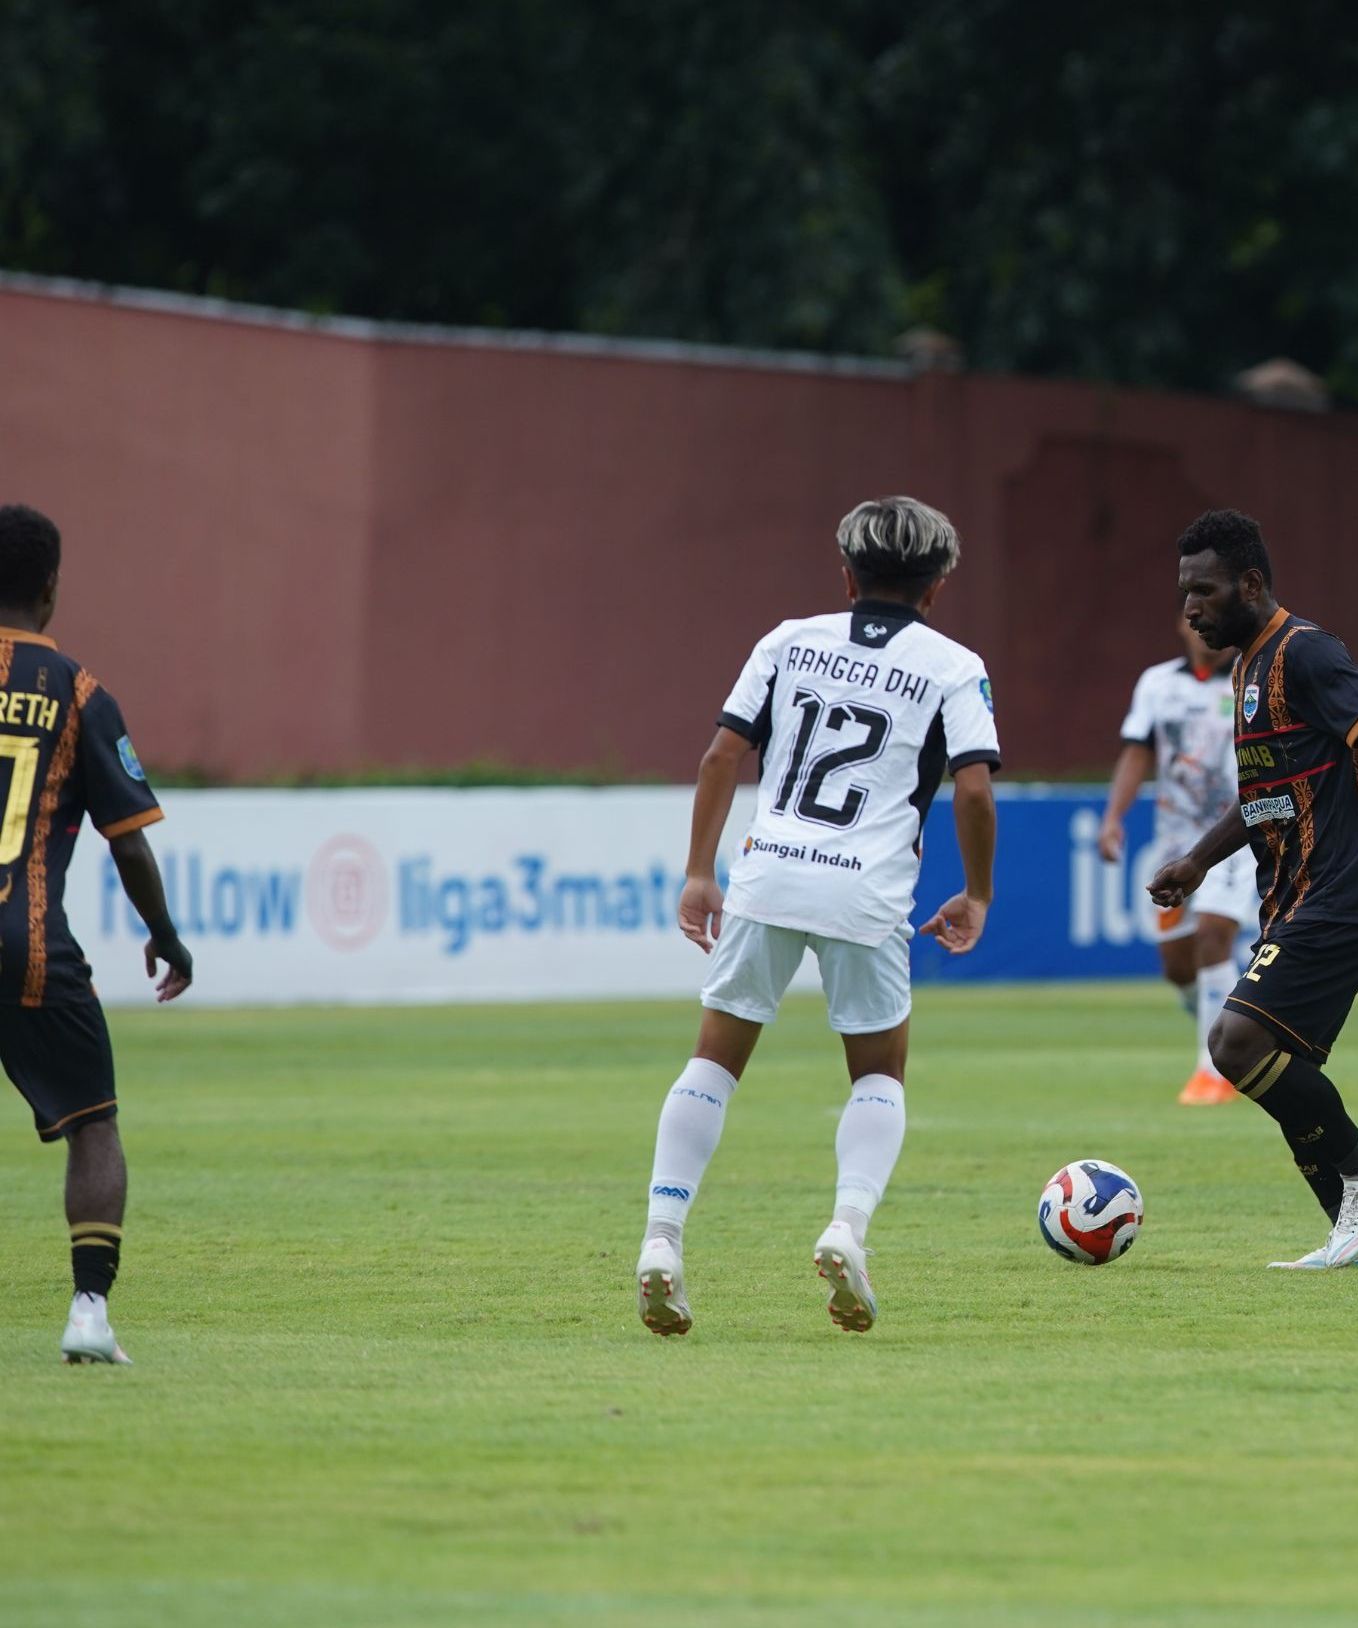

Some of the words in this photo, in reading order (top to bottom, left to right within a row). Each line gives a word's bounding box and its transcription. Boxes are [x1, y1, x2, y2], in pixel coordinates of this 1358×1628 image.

[787, 646, 879, 688] RANGGA
[885, 668, 929, 704] DWI
[770, 686, 892, 830] 12
[753, 838, 806, 861] Sungai
[811, 849, 862, 872] Indah
[100, 848, 301, 939] fllow
